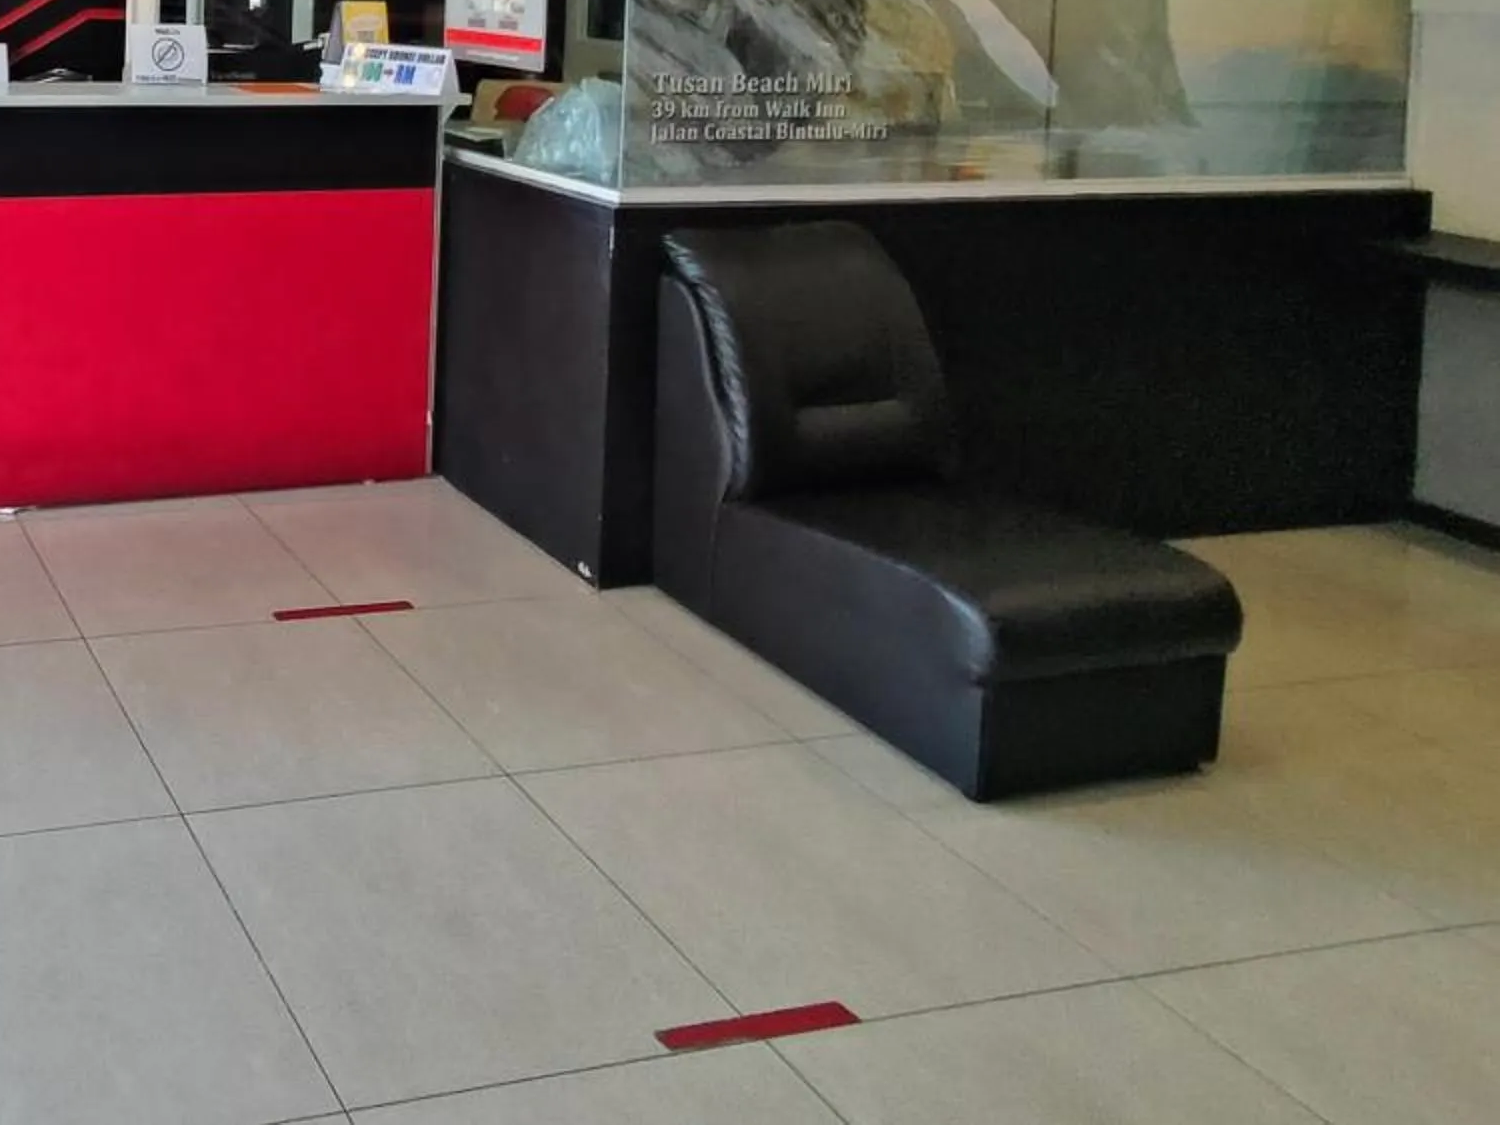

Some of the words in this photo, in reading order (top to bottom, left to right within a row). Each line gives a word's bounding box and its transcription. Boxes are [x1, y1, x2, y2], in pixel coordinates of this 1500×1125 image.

[653, 74, 723, 95] Tusan
[730, 73, 798, 94] Beach
[806, 73, 852, 94] Miri
[651, 100, 676, 119] 39
[681, 100, 710, 118] km
[713, 100, 759, 118] from
[766, 100, 811, 118] Walk
[815, 100, 846, 118] Inn
[651, 123, 698, 143] Jalan
[704, 123, 771, 141] Coastal
[776, 122, 888, 141] Bintulu-Miri
